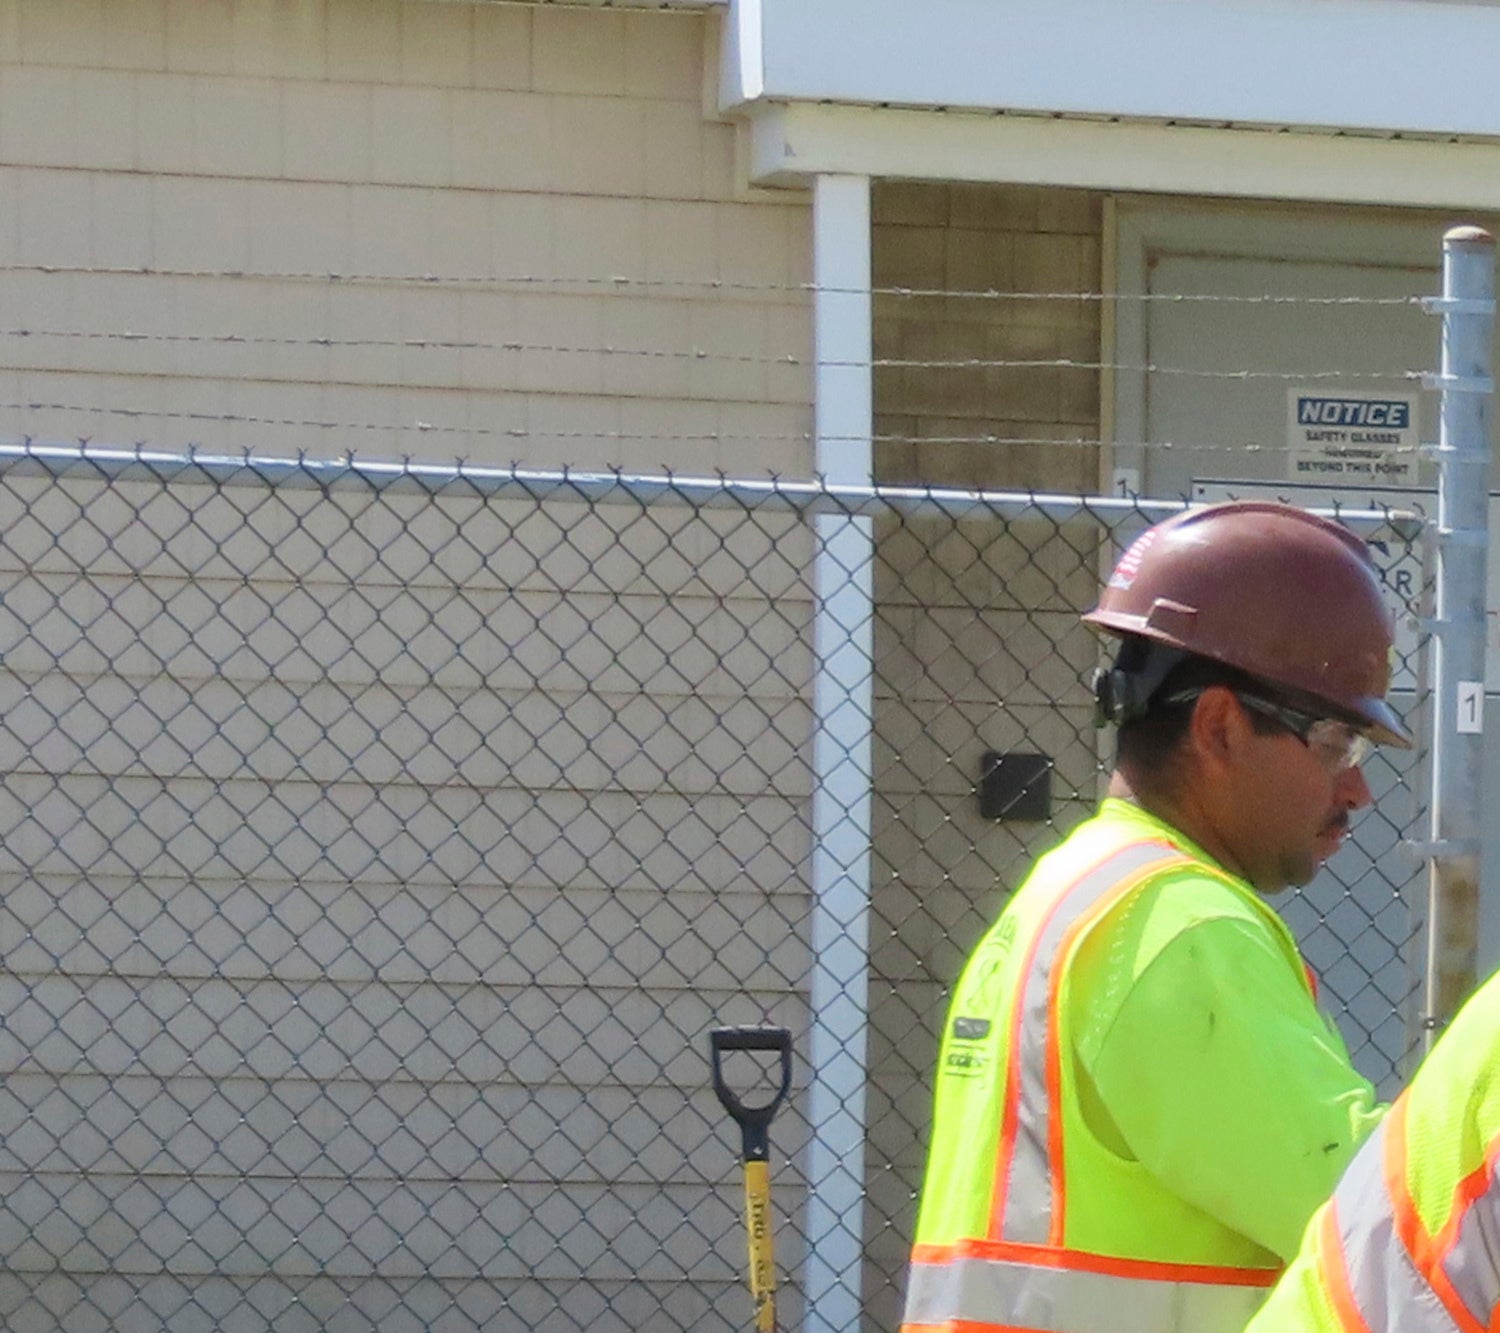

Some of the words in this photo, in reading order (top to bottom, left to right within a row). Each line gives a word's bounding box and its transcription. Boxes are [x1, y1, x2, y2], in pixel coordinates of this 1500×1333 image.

[1302, 401, 1406, 425] NOTICE
[1305, 430, 1347, 442] SAFETY
[1351, 432, 1400, 444] GLASSES
[1297, 461, 1343, 472] BEYOND
[1346, 463, 1372, 473] THIS
[1375, 463, 1409, 475] POINT
[1464, 693, 1477, 723] 1
